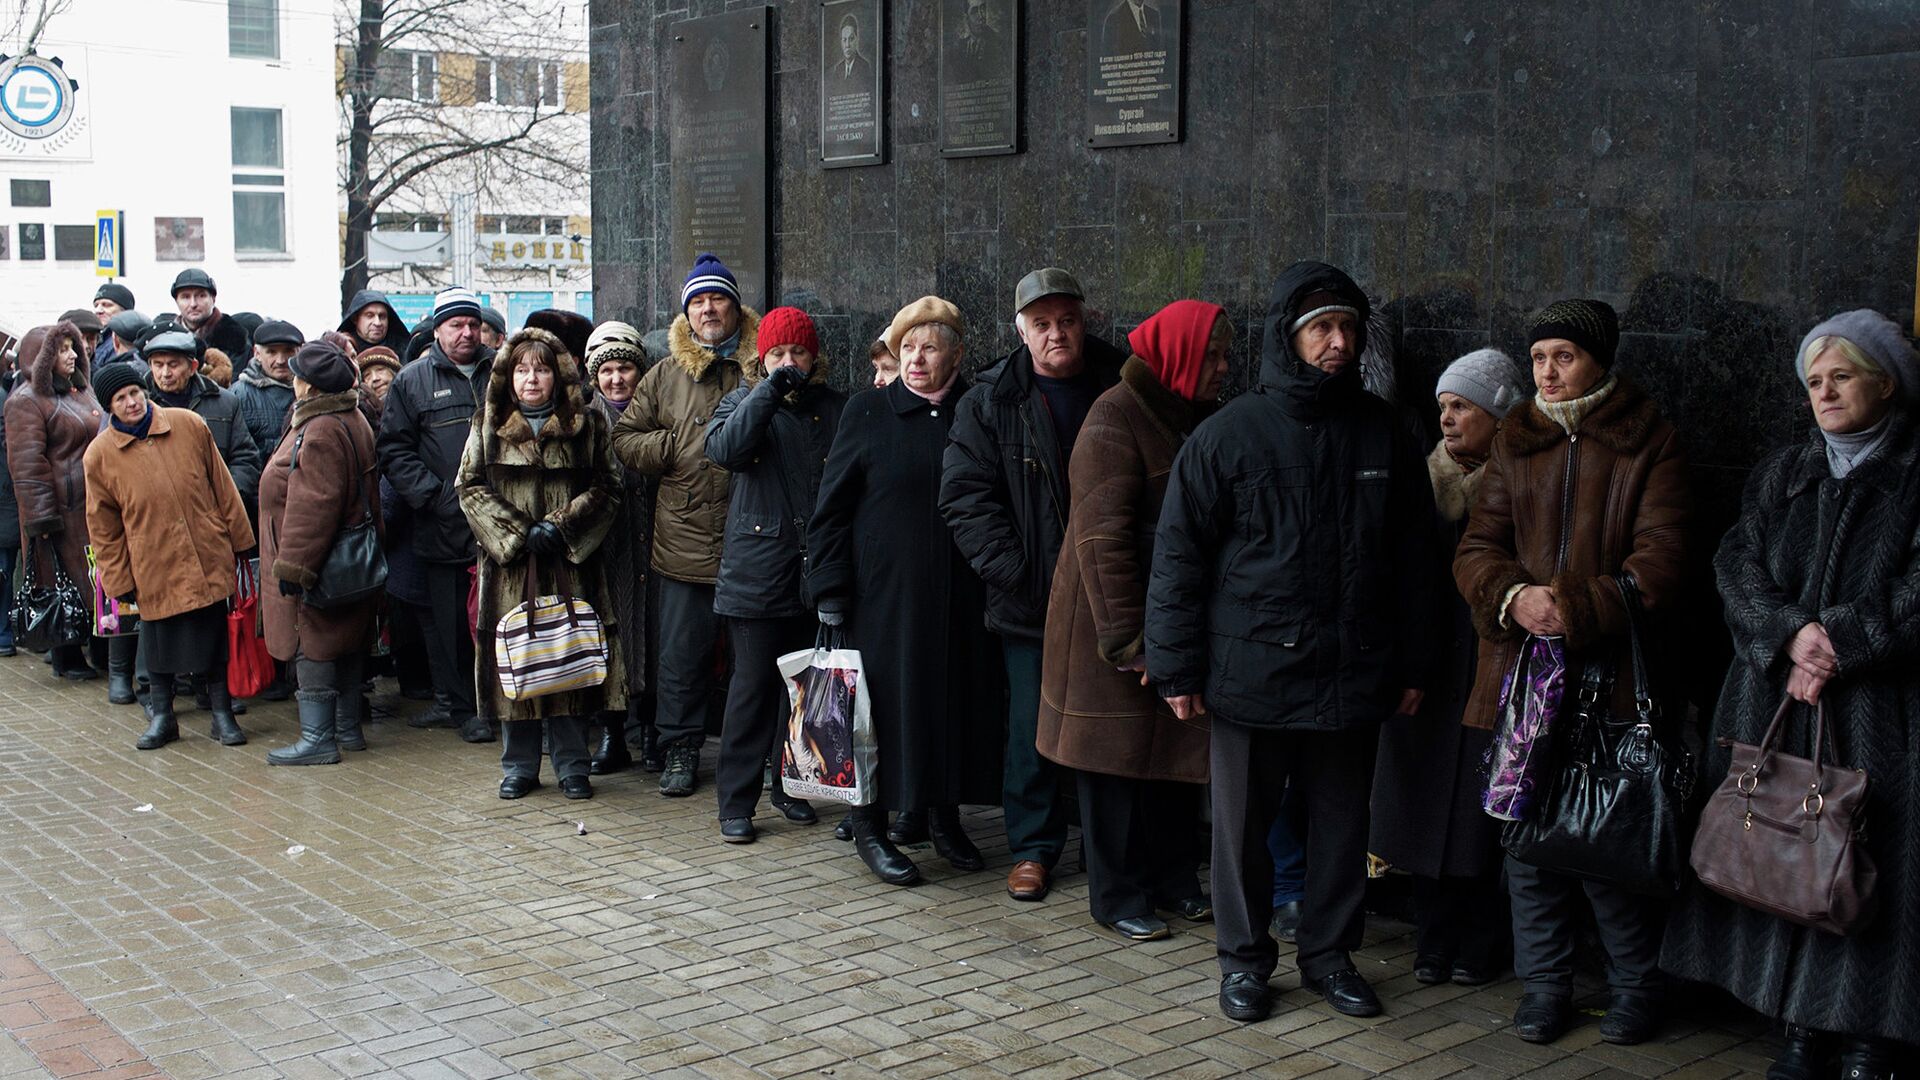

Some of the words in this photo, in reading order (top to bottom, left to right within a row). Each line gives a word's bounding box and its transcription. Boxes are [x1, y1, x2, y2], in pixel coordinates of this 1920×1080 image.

[1119, 107, 1144, 121] Сургай
[1094, 122, 1126, 136] Николай
[1127, 121, 1170, 134] Сафонович
[491, 241, 584, 262] ДОНЕЦ
